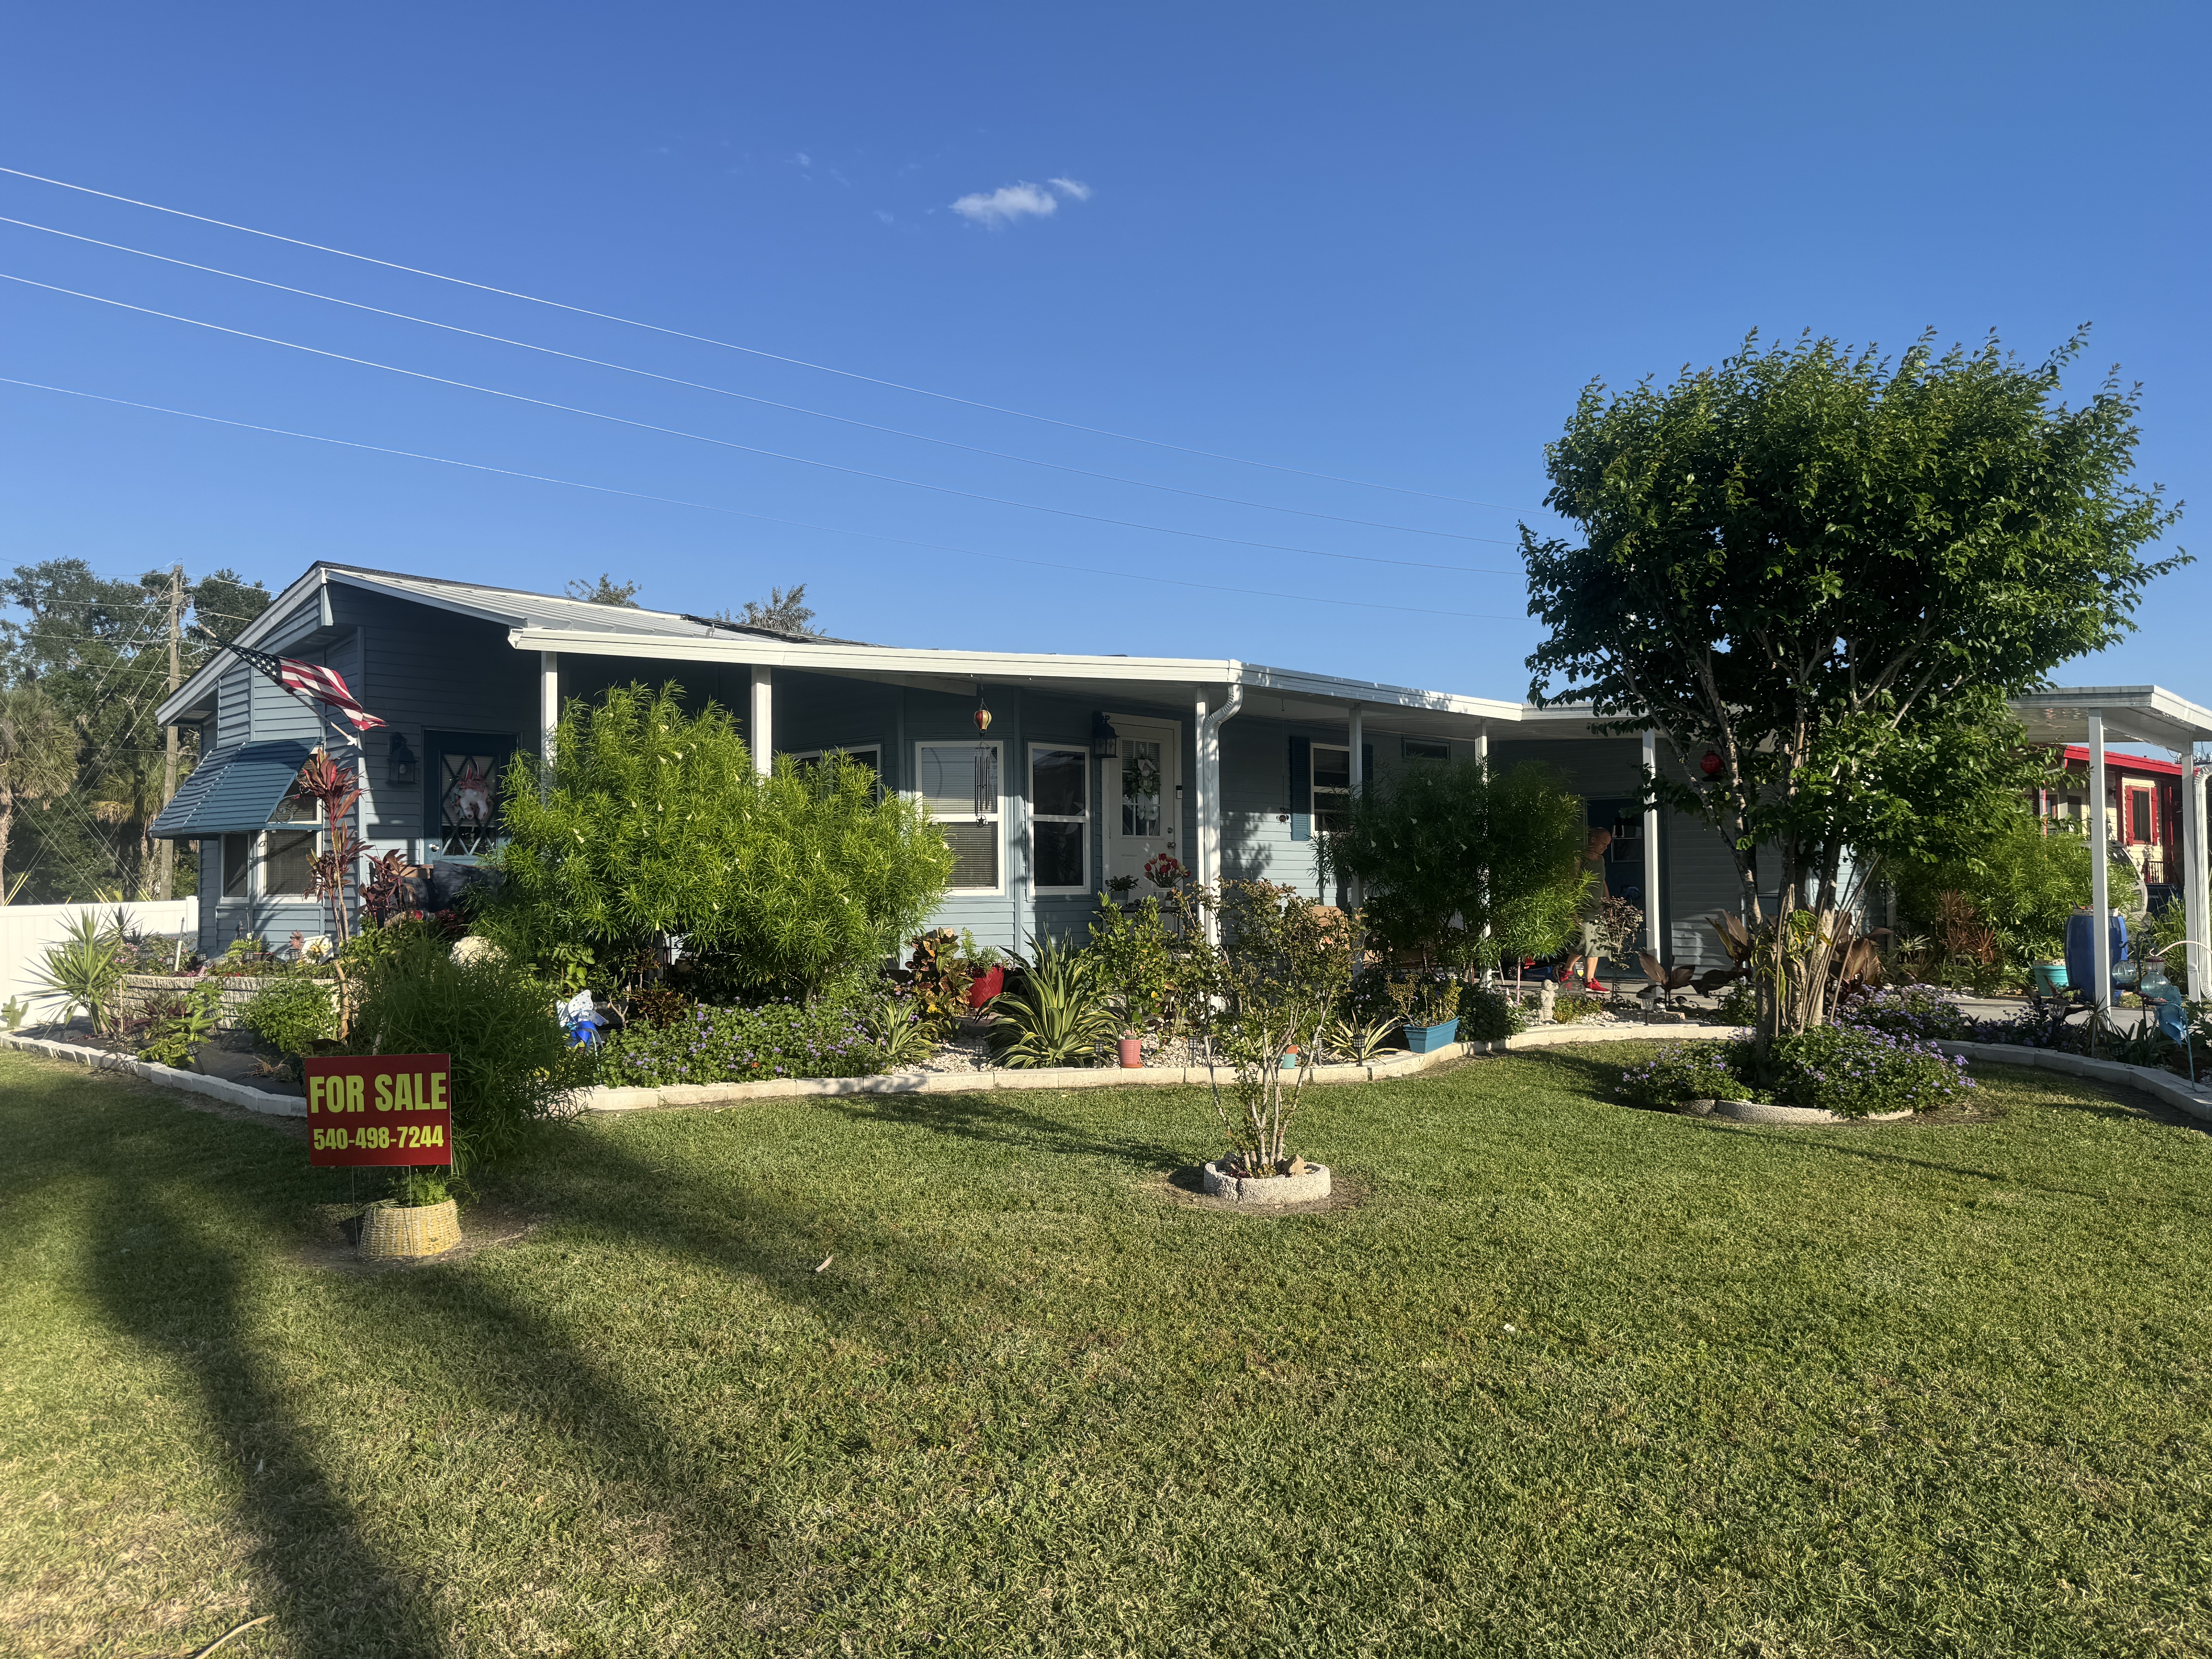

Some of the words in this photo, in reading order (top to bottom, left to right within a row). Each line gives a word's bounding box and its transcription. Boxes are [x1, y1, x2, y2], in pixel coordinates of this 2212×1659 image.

[310, 1075, 364, 1113] FOR
[375, 1072, 447, 1111] SALE
[313, 1125, 444, 1150] 540-498-7244
